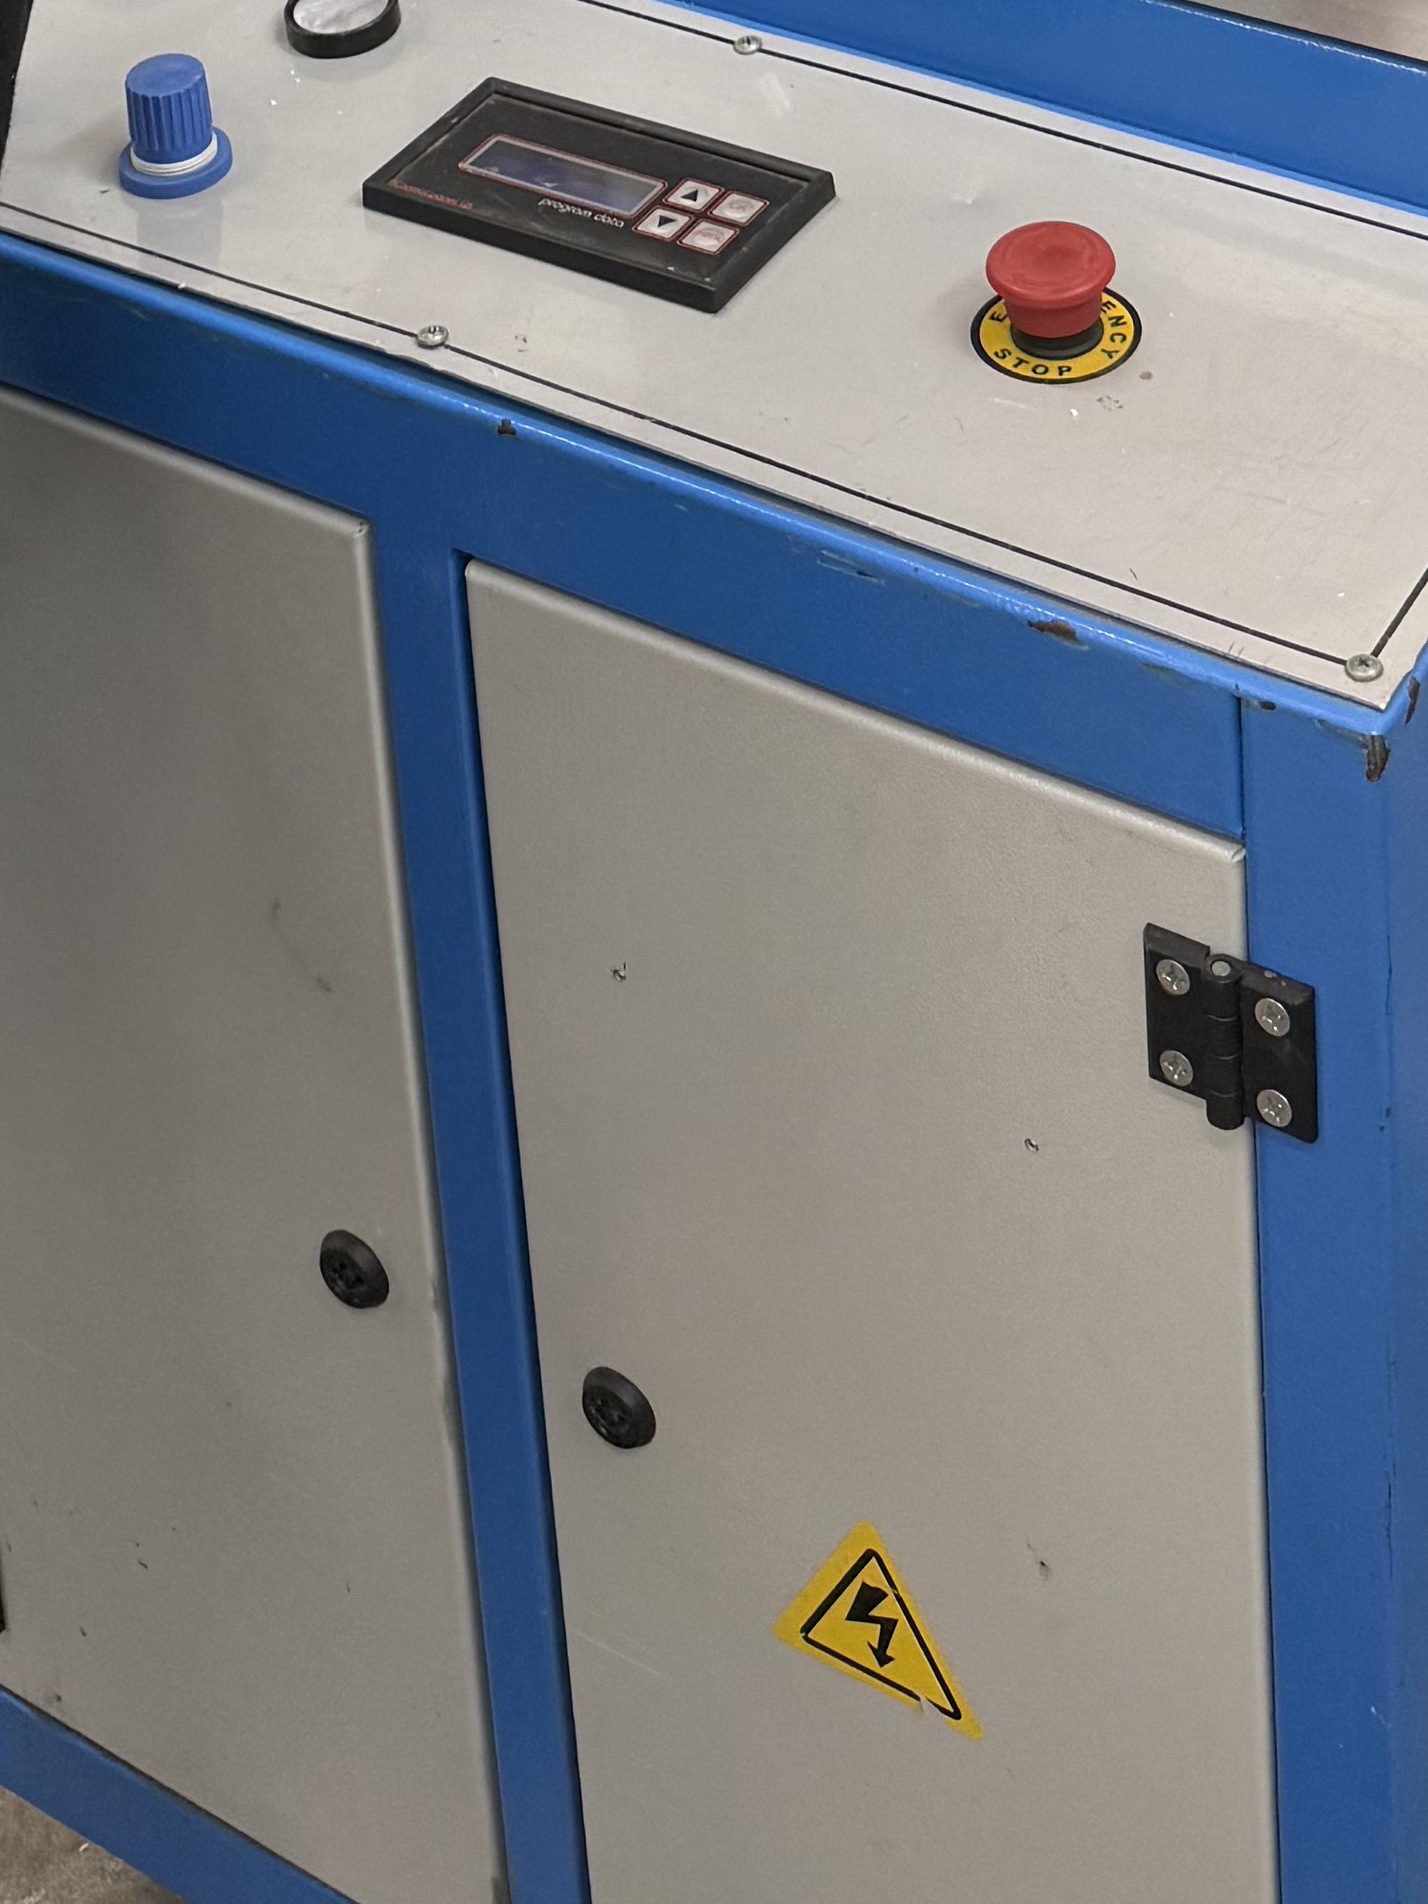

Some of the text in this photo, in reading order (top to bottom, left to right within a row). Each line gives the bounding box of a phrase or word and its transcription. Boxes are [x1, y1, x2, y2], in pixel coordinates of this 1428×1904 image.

[537, 198, 625, 228] program data
[994, 348, 1072, 377] STOP
